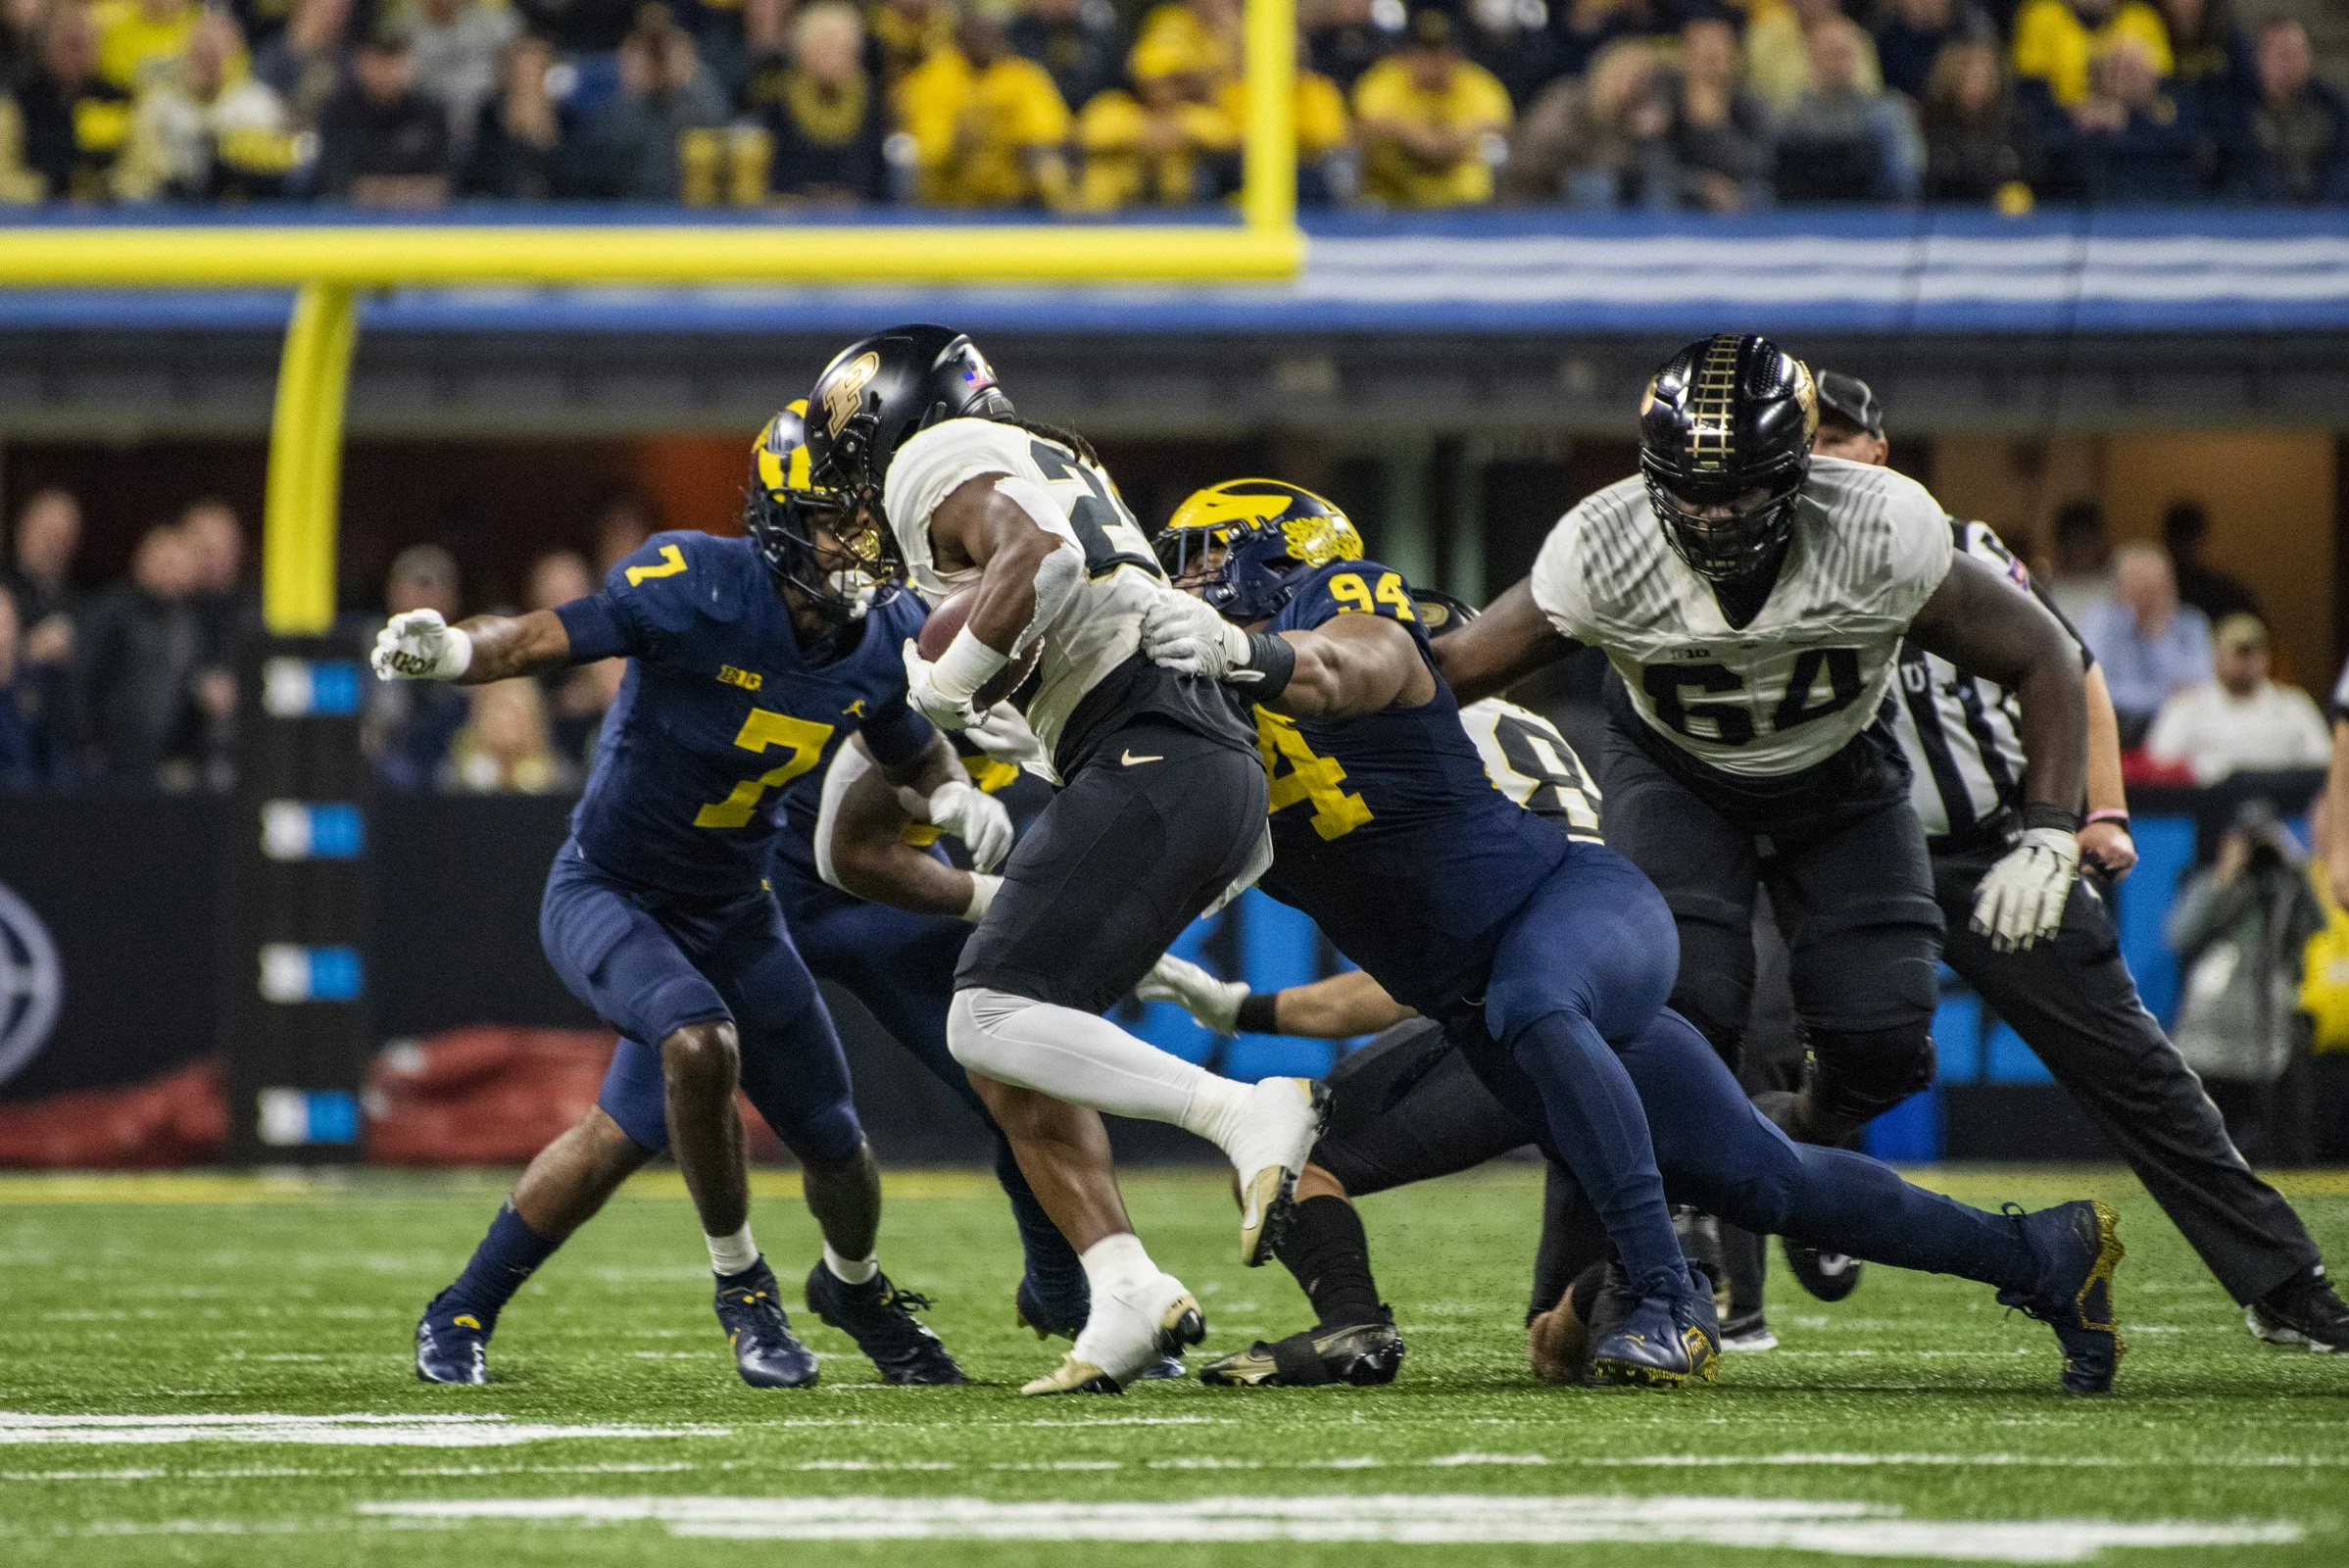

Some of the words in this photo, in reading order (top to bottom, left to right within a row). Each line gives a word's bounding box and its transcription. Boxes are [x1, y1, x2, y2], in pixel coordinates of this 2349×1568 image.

[822, 351, 880, 439] P
[624, 544, 688, 587] 7
[1328, 572, 1416, 621] 94
[1642, 647, 1867, 748] 64
[693, 708, 835, 828] 7
